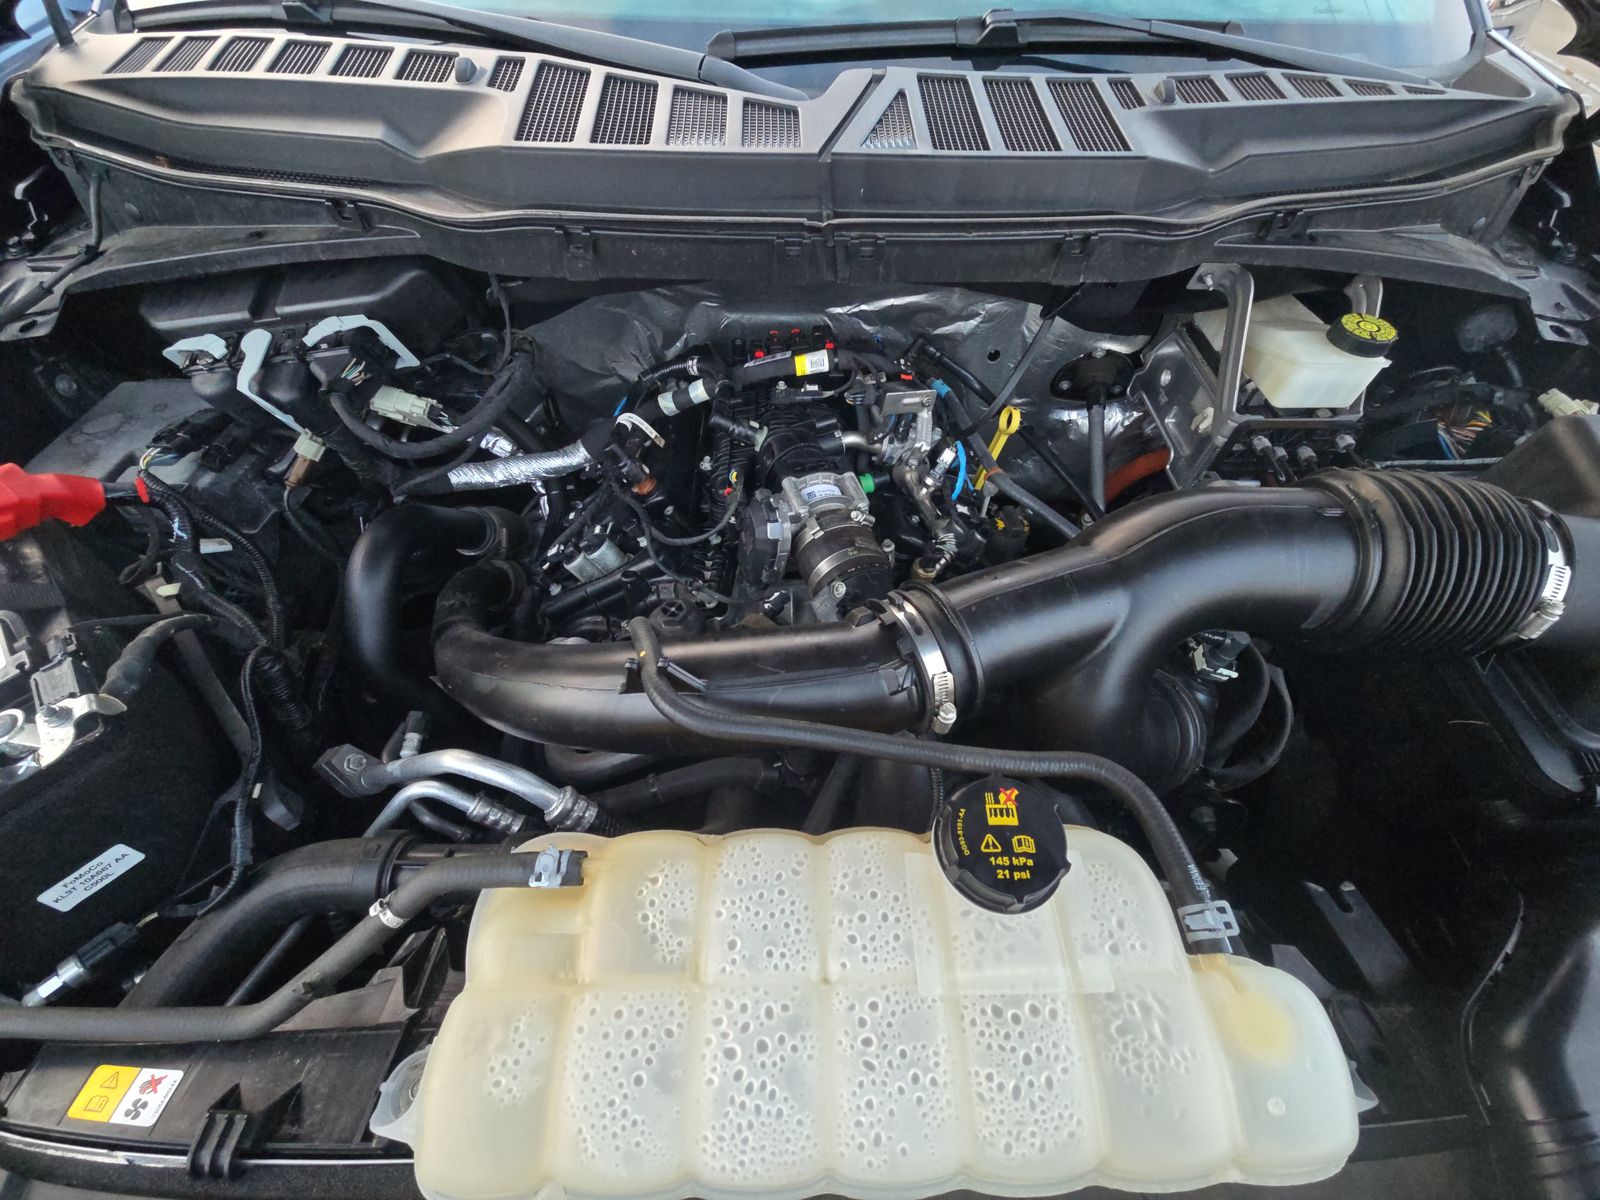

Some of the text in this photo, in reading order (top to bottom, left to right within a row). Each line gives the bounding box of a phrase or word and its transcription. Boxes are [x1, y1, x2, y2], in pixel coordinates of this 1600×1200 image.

[114, 852, 130, 863] AA
[989, 856, 1034, 866] 145 kPa
[62, 861, 104, 888] FoMoCo
[996, 869, 1031, 881] 21 psi
